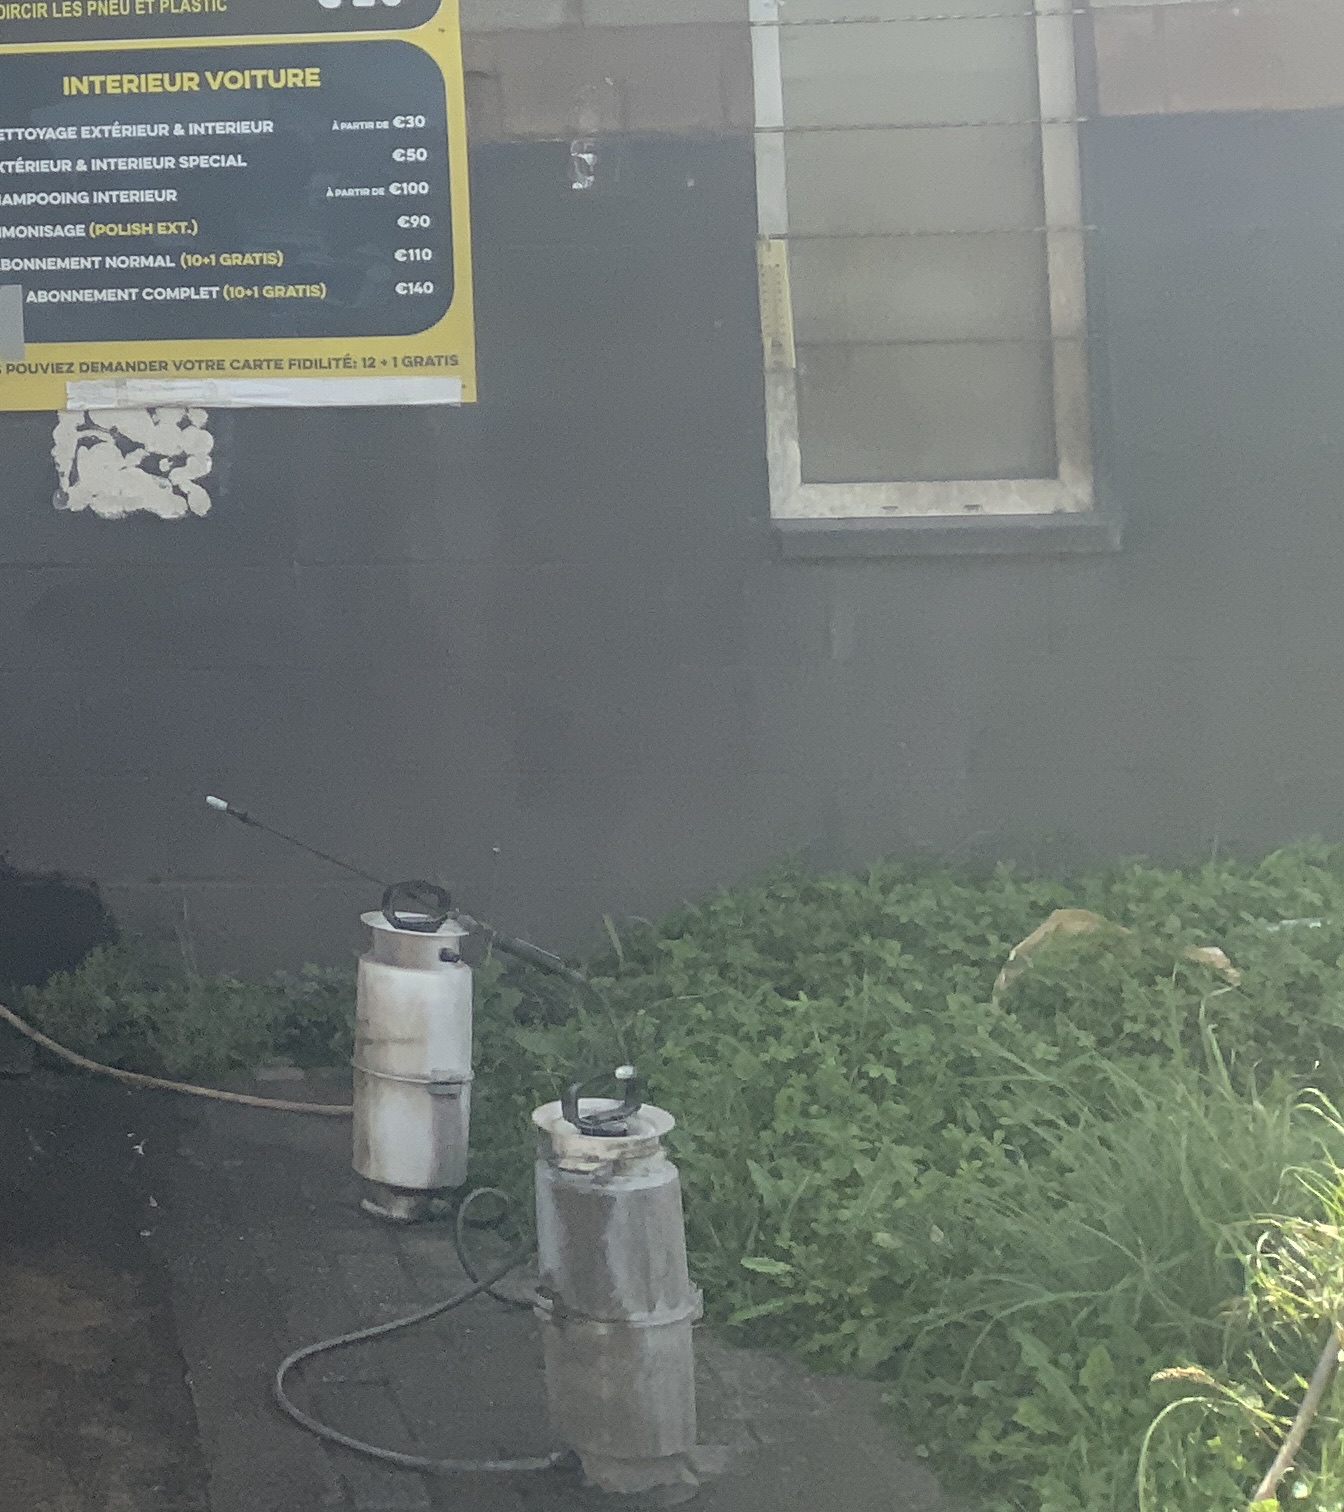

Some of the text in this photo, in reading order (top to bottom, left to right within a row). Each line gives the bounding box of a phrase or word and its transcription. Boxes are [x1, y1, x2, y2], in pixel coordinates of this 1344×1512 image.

[53, 3, 82, 18] LES
[88, 1, 129, 17] PNEU
[135, 0, 153, 14] ET
[63, 68, 321, 96] INTERIEUR VOITURE
[81, 122, 169, 139] EXTÉRIEUR
[189, 121, 273, 135] INTERIEUR
[392, 115, 425, 128] €30
[91, 157, 175, 172] INTERIEUR
[179, 154, 247, 168] SPECIAL
[392, 148, 427, 161] €50
[93, 190, 177, 204] INTERIEUR
[389, 182, 429, 195] €100
[89, 222, 153, 238] (POLISH
[158, 219, 198, 236] EXT.)
[397, 215, 430, 227] €90
[105, 254, 175, 268] NORMAL
[181, 252, 216, 269] (10+1
[219, 250, 283, 267] GRATIS)
[394, 248, 432, 261] €110
[26, 288, 138, 303] ABONNEMENT
[142, 286, 219, 300] COMPLET
[223, 285, 259, 301] (10+1
[263, 283, 326, 299] GRATIS)
[395, 282, 433, 294] €140
[6, 362, 74, 374] POUVIEZ
[79, 361, 168, 373] DEMANDER
[172, 359, 225, 371] VOTRE
[230, 359, 283, 370] CARTE
[288, 353, 357, 369] FIDILITÉ:
[362, 358, 375, 368] 12
[401, 355, 459, 367] GRATIS
